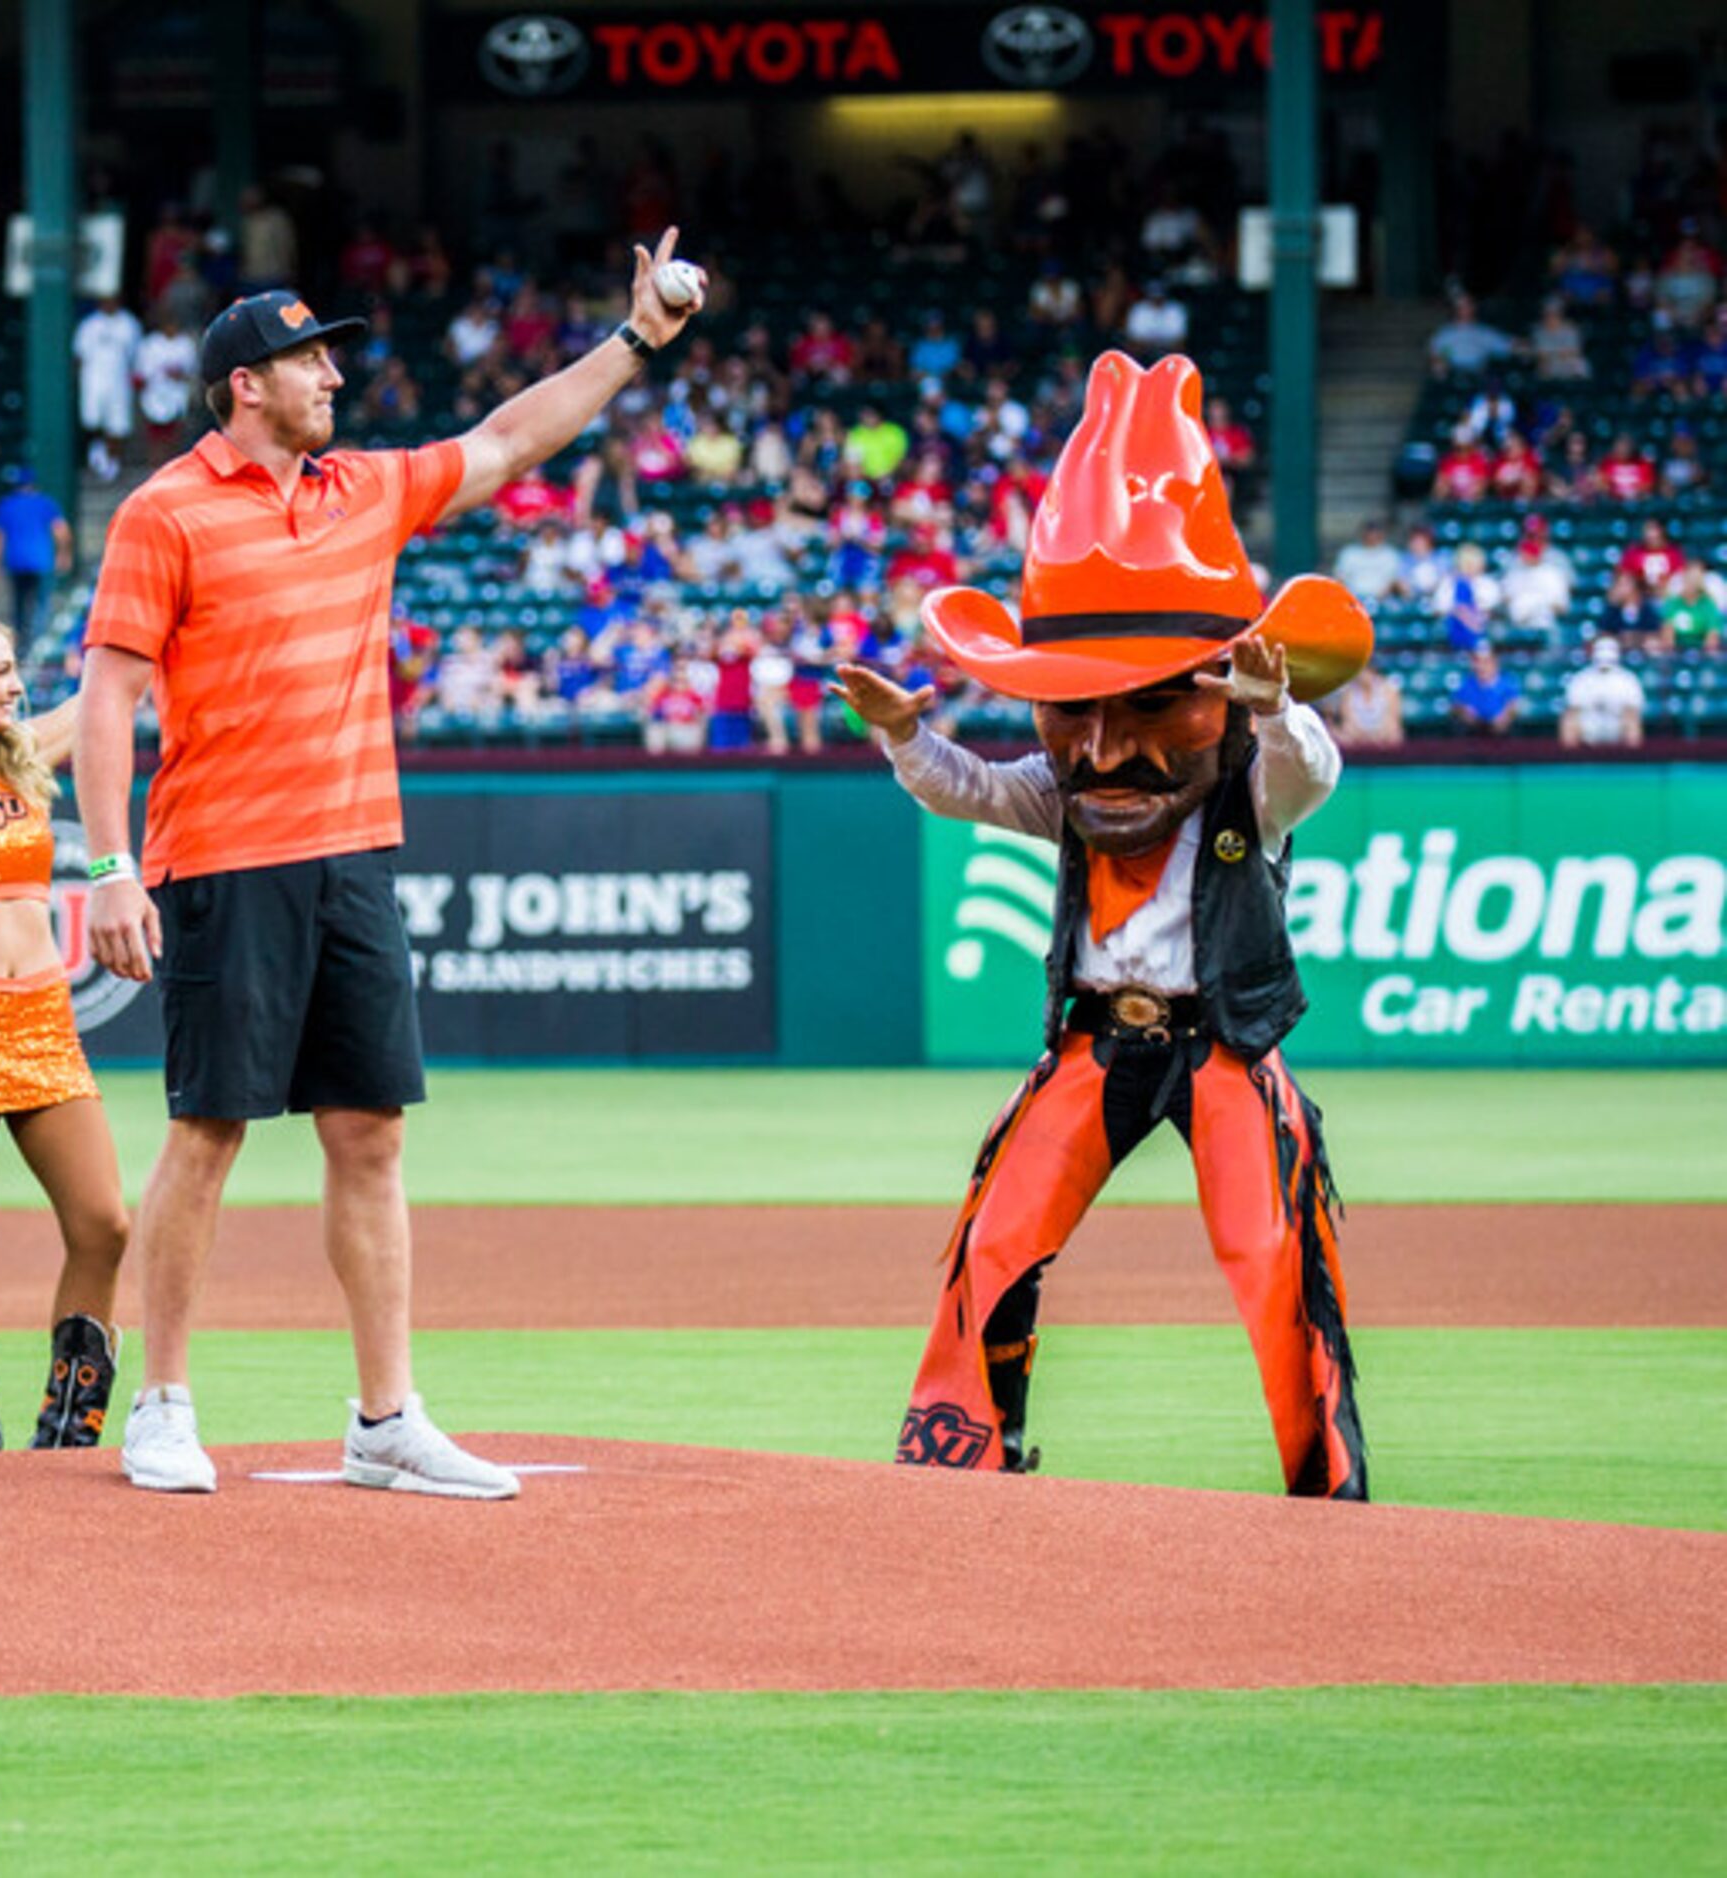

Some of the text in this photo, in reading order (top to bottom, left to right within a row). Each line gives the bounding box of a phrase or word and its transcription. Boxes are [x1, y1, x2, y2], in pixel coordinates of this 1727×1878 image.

[595, 20, 901, 86] TOYOTA
[468, 871, 752, 949] JOHN'S
[1286, 828, 1727, 961] ationa
[431, 949, 753, 991] SANDWICHES
[1362, 974, 1488, 1033] Car
